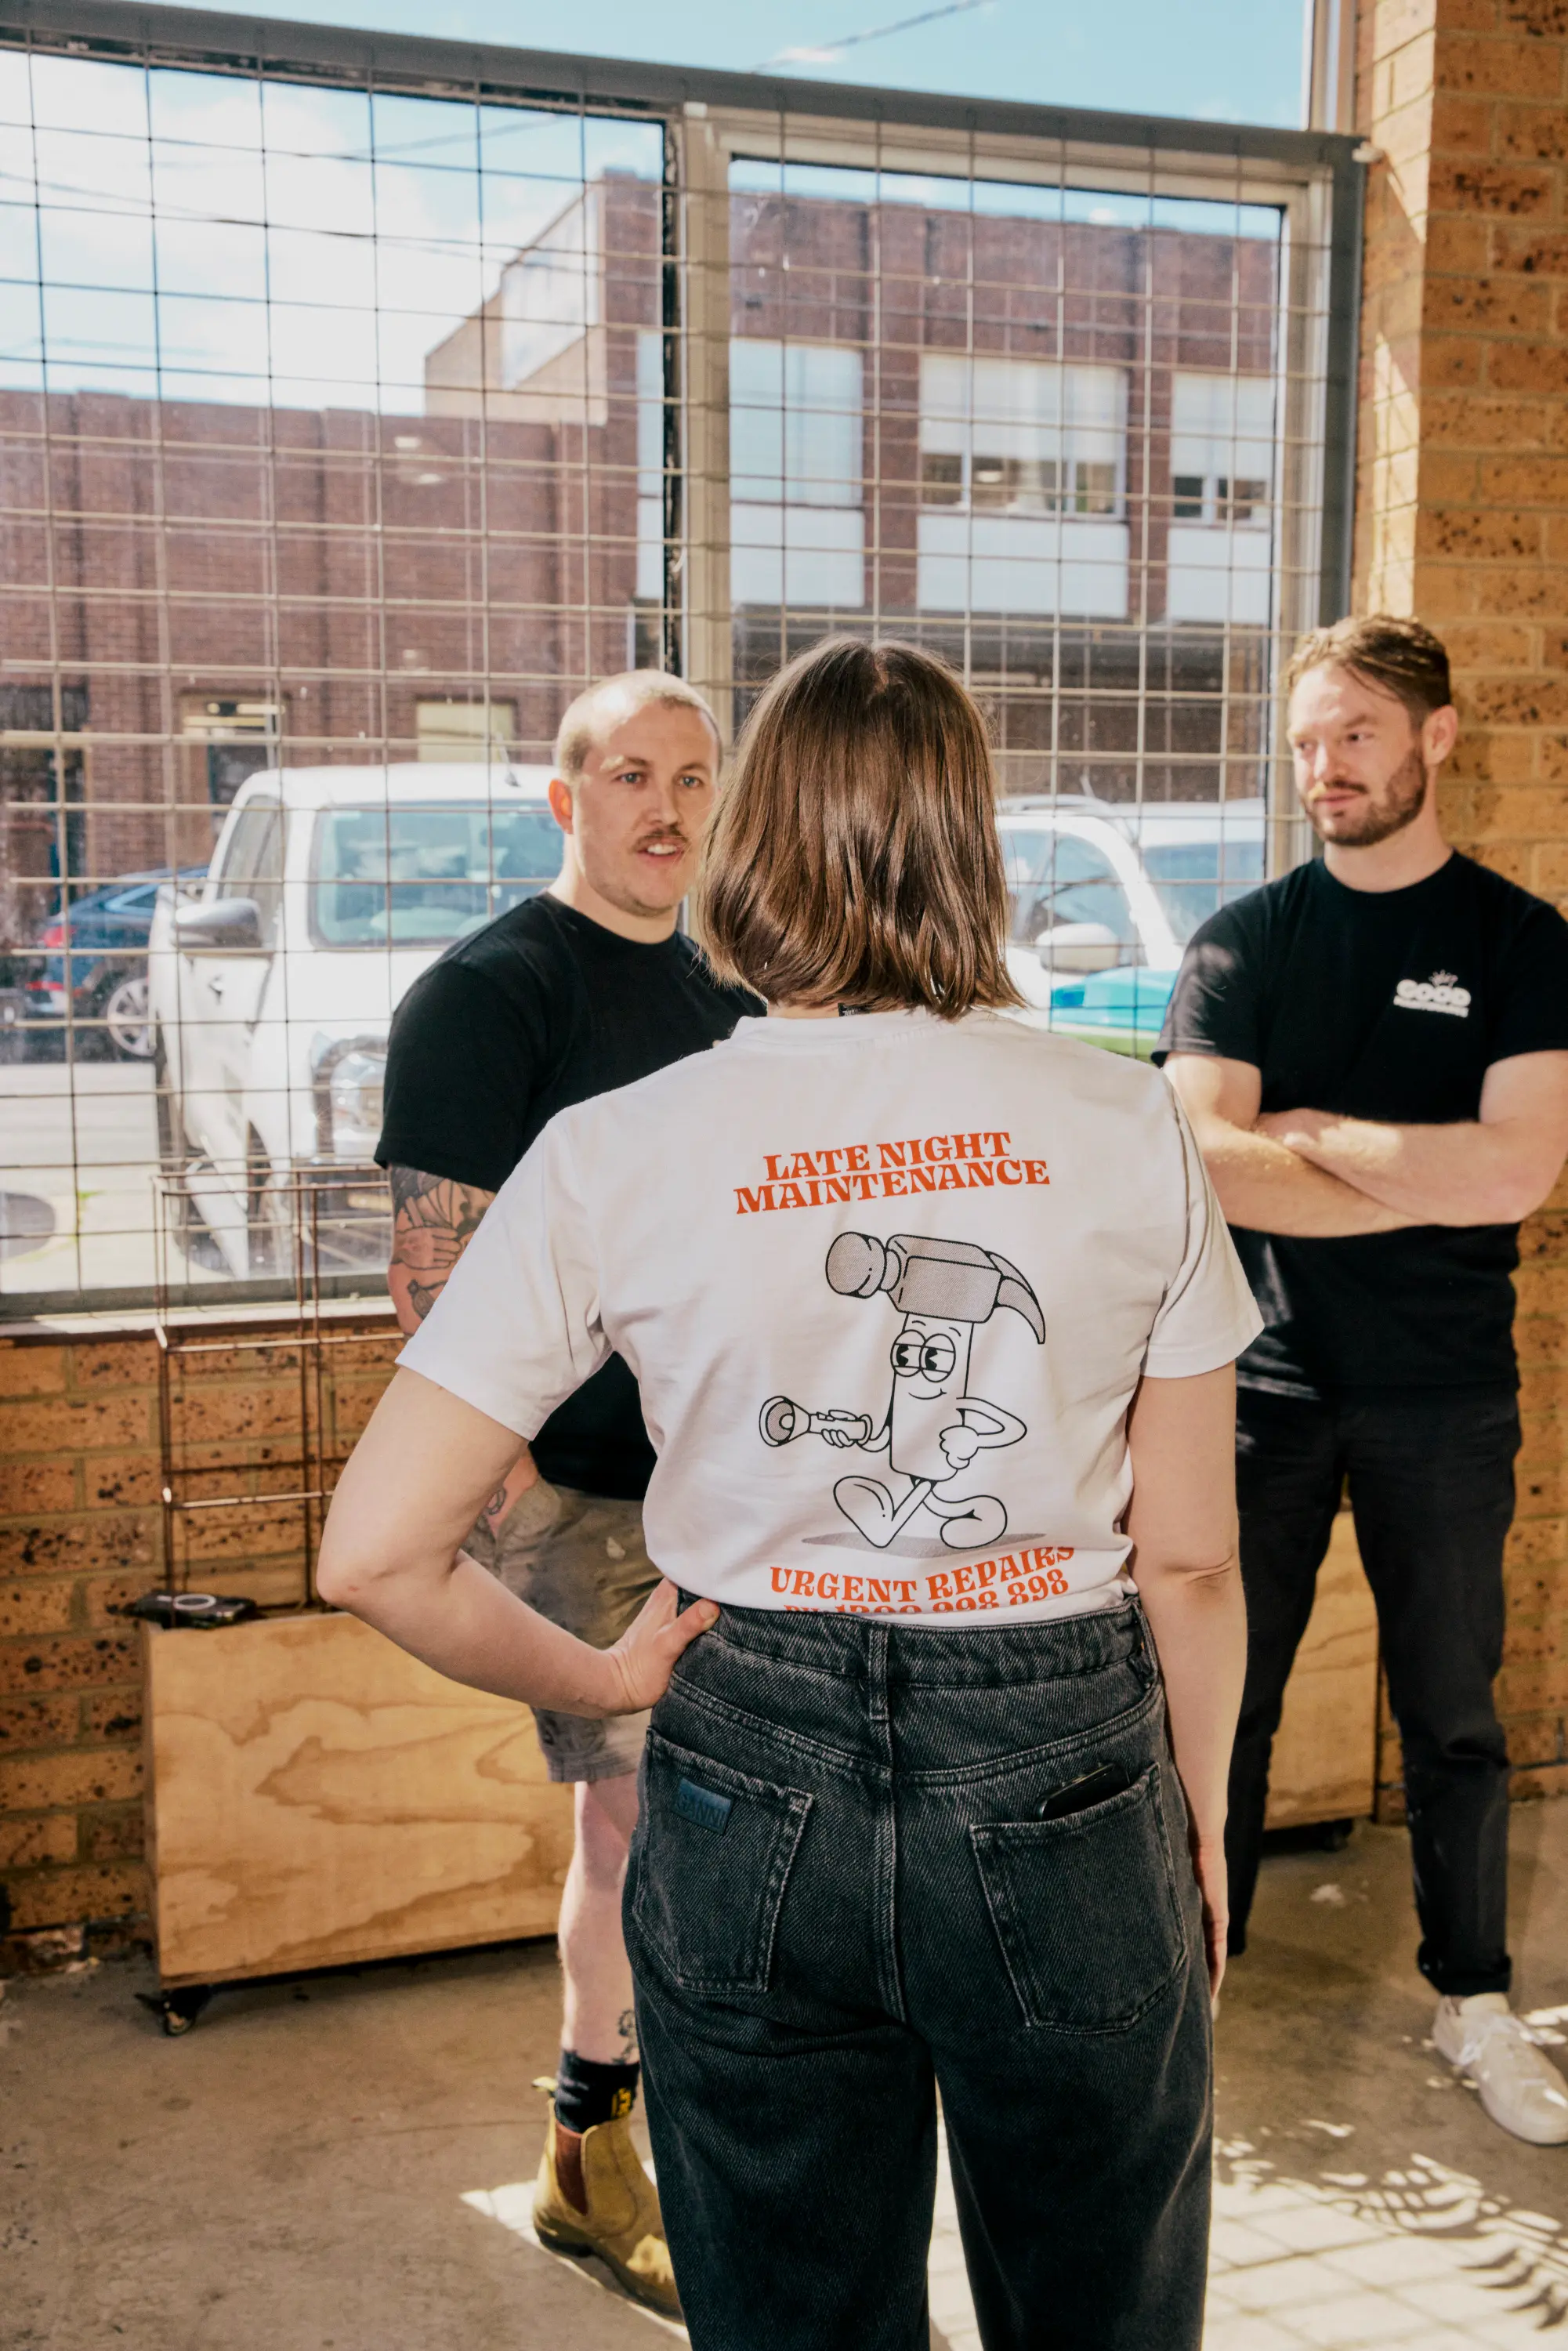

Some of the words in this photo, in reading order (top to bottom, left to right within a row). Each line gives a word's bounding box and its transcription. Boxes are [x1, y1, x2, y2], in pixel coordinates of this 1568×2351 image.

[763, 1145, 870, 1181] LATE
[877, 1132, 1011, 1168] NIGHT
[734, 1160, 1050, 1215] MAINTENANCE
[770, 1567, 918, 1603] URGENT
[925, 1546, 1074, 1600] REPAIRS
[1007, 1569, 1069, 1606] 898
